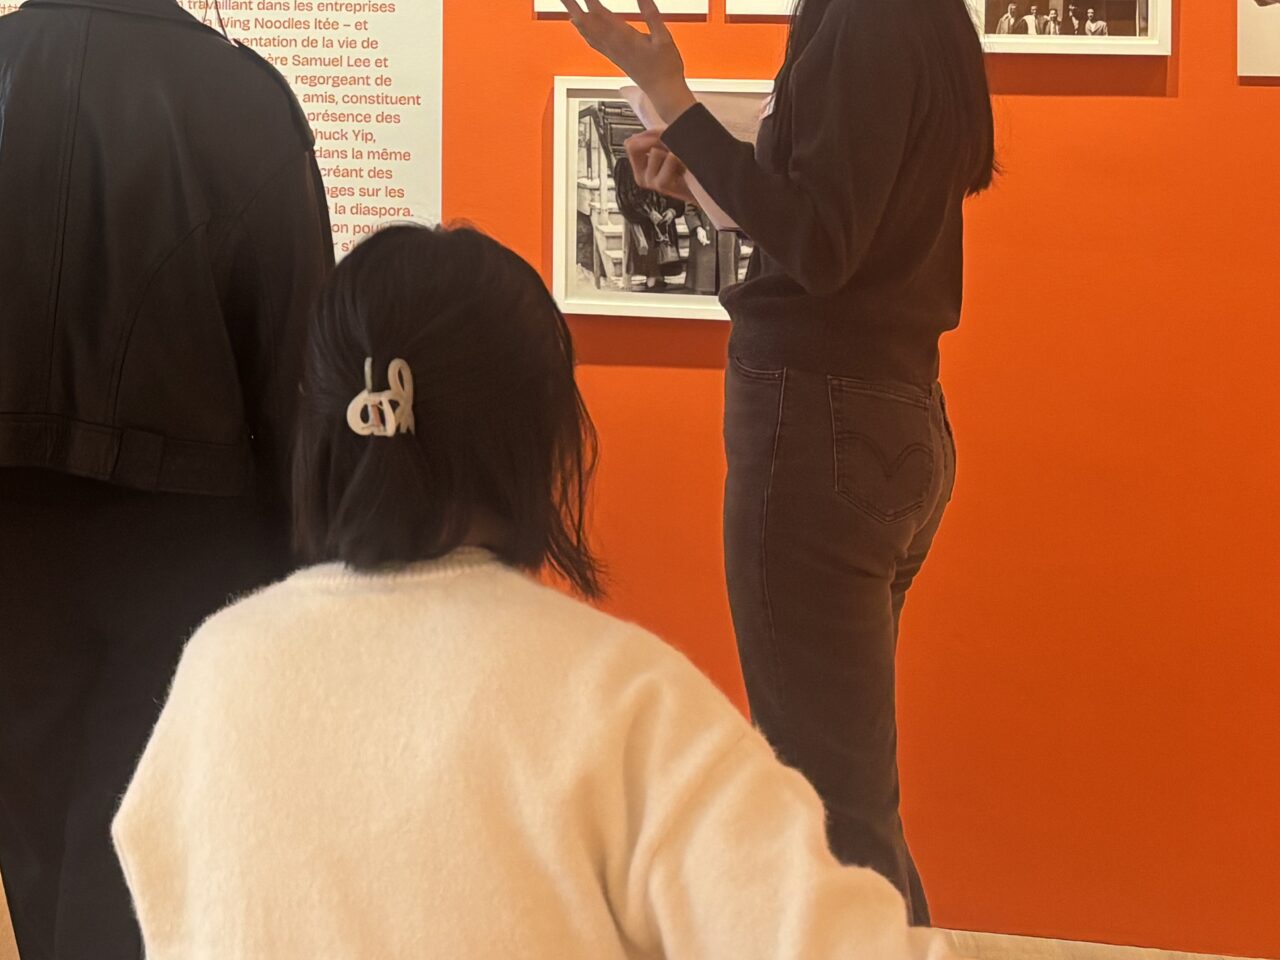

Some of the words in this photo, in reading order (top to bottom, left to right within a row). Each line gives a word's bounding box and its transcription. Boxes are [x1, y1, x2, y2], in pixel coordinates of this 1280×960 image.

[256, 0, 291, 12] dans
[293, 0, 314, 12] les
[316, 0, 396, 15] entreprises
[254, 17, 311, 30] Noodles
[354, 19, 369, 31] et
[300, 35, 319, 49] de
[321, 35, 334, 49] la
[337, 36, 358, 49] vie
[360, 36, 379, 50] de
[291, 54, 343, 68] Samuel
[346, 55, 371, 68] Lee
[374, 57, 389, 69] et
[294, 74, 371, 89] regorgeant
[374, 74, 393, 87] de
[302, 92, 339, 106] amis,
[341, 92, 422, 106] constituent
[306, 109, 372, 124] présence
[375, 111, 401, 124] des
[313, 128, 349, 141] huck
[351, 129, 376, 144] Yip,
[351, 147, 364, 160] la
[367, 147, 411, 162] même
[320, 166, 364, 179] créant
[367, 166, 393, 180] des
[358, 186, 382, 198] sur
[384, 185, 405, 199] les
[334, 202, 347, 215] la
[349, 202, 415, 219] diaspora.
